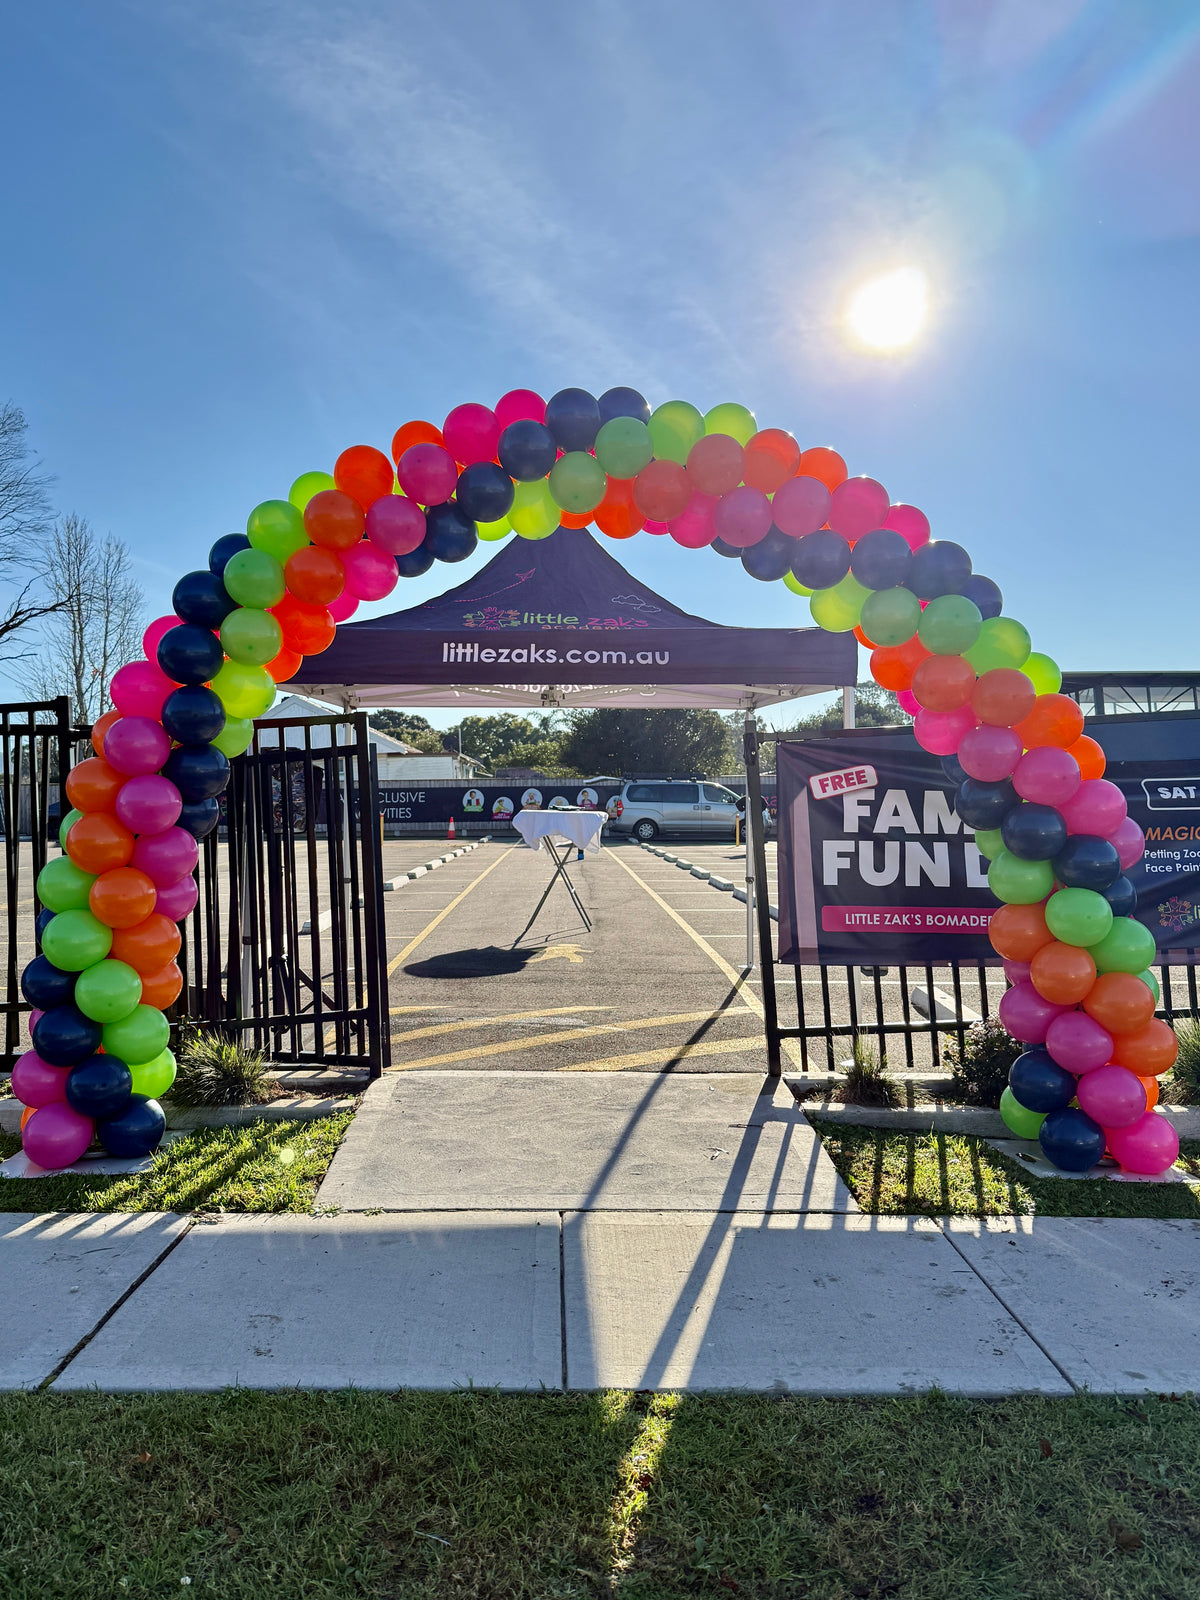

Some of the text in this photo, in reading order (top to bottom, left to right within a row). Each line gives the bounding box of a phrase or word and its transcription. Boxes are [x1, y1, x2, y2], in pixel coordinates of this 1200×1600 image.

[523, 612, 580, 625] little
[442, 642, 670, 665] littlezaks.com.au
[818, 769, 868, 794] FREE
[1157, 786, 1197, 800] SAT
[1144, 849, 1181, 861] Petting
[822, 840, 951, 887] FUN
[1145, 862, 1200, 873] Face Pain
[845, 913, 880, 925] LITTLE
[883, 913, 922, 926] ZAK'S
